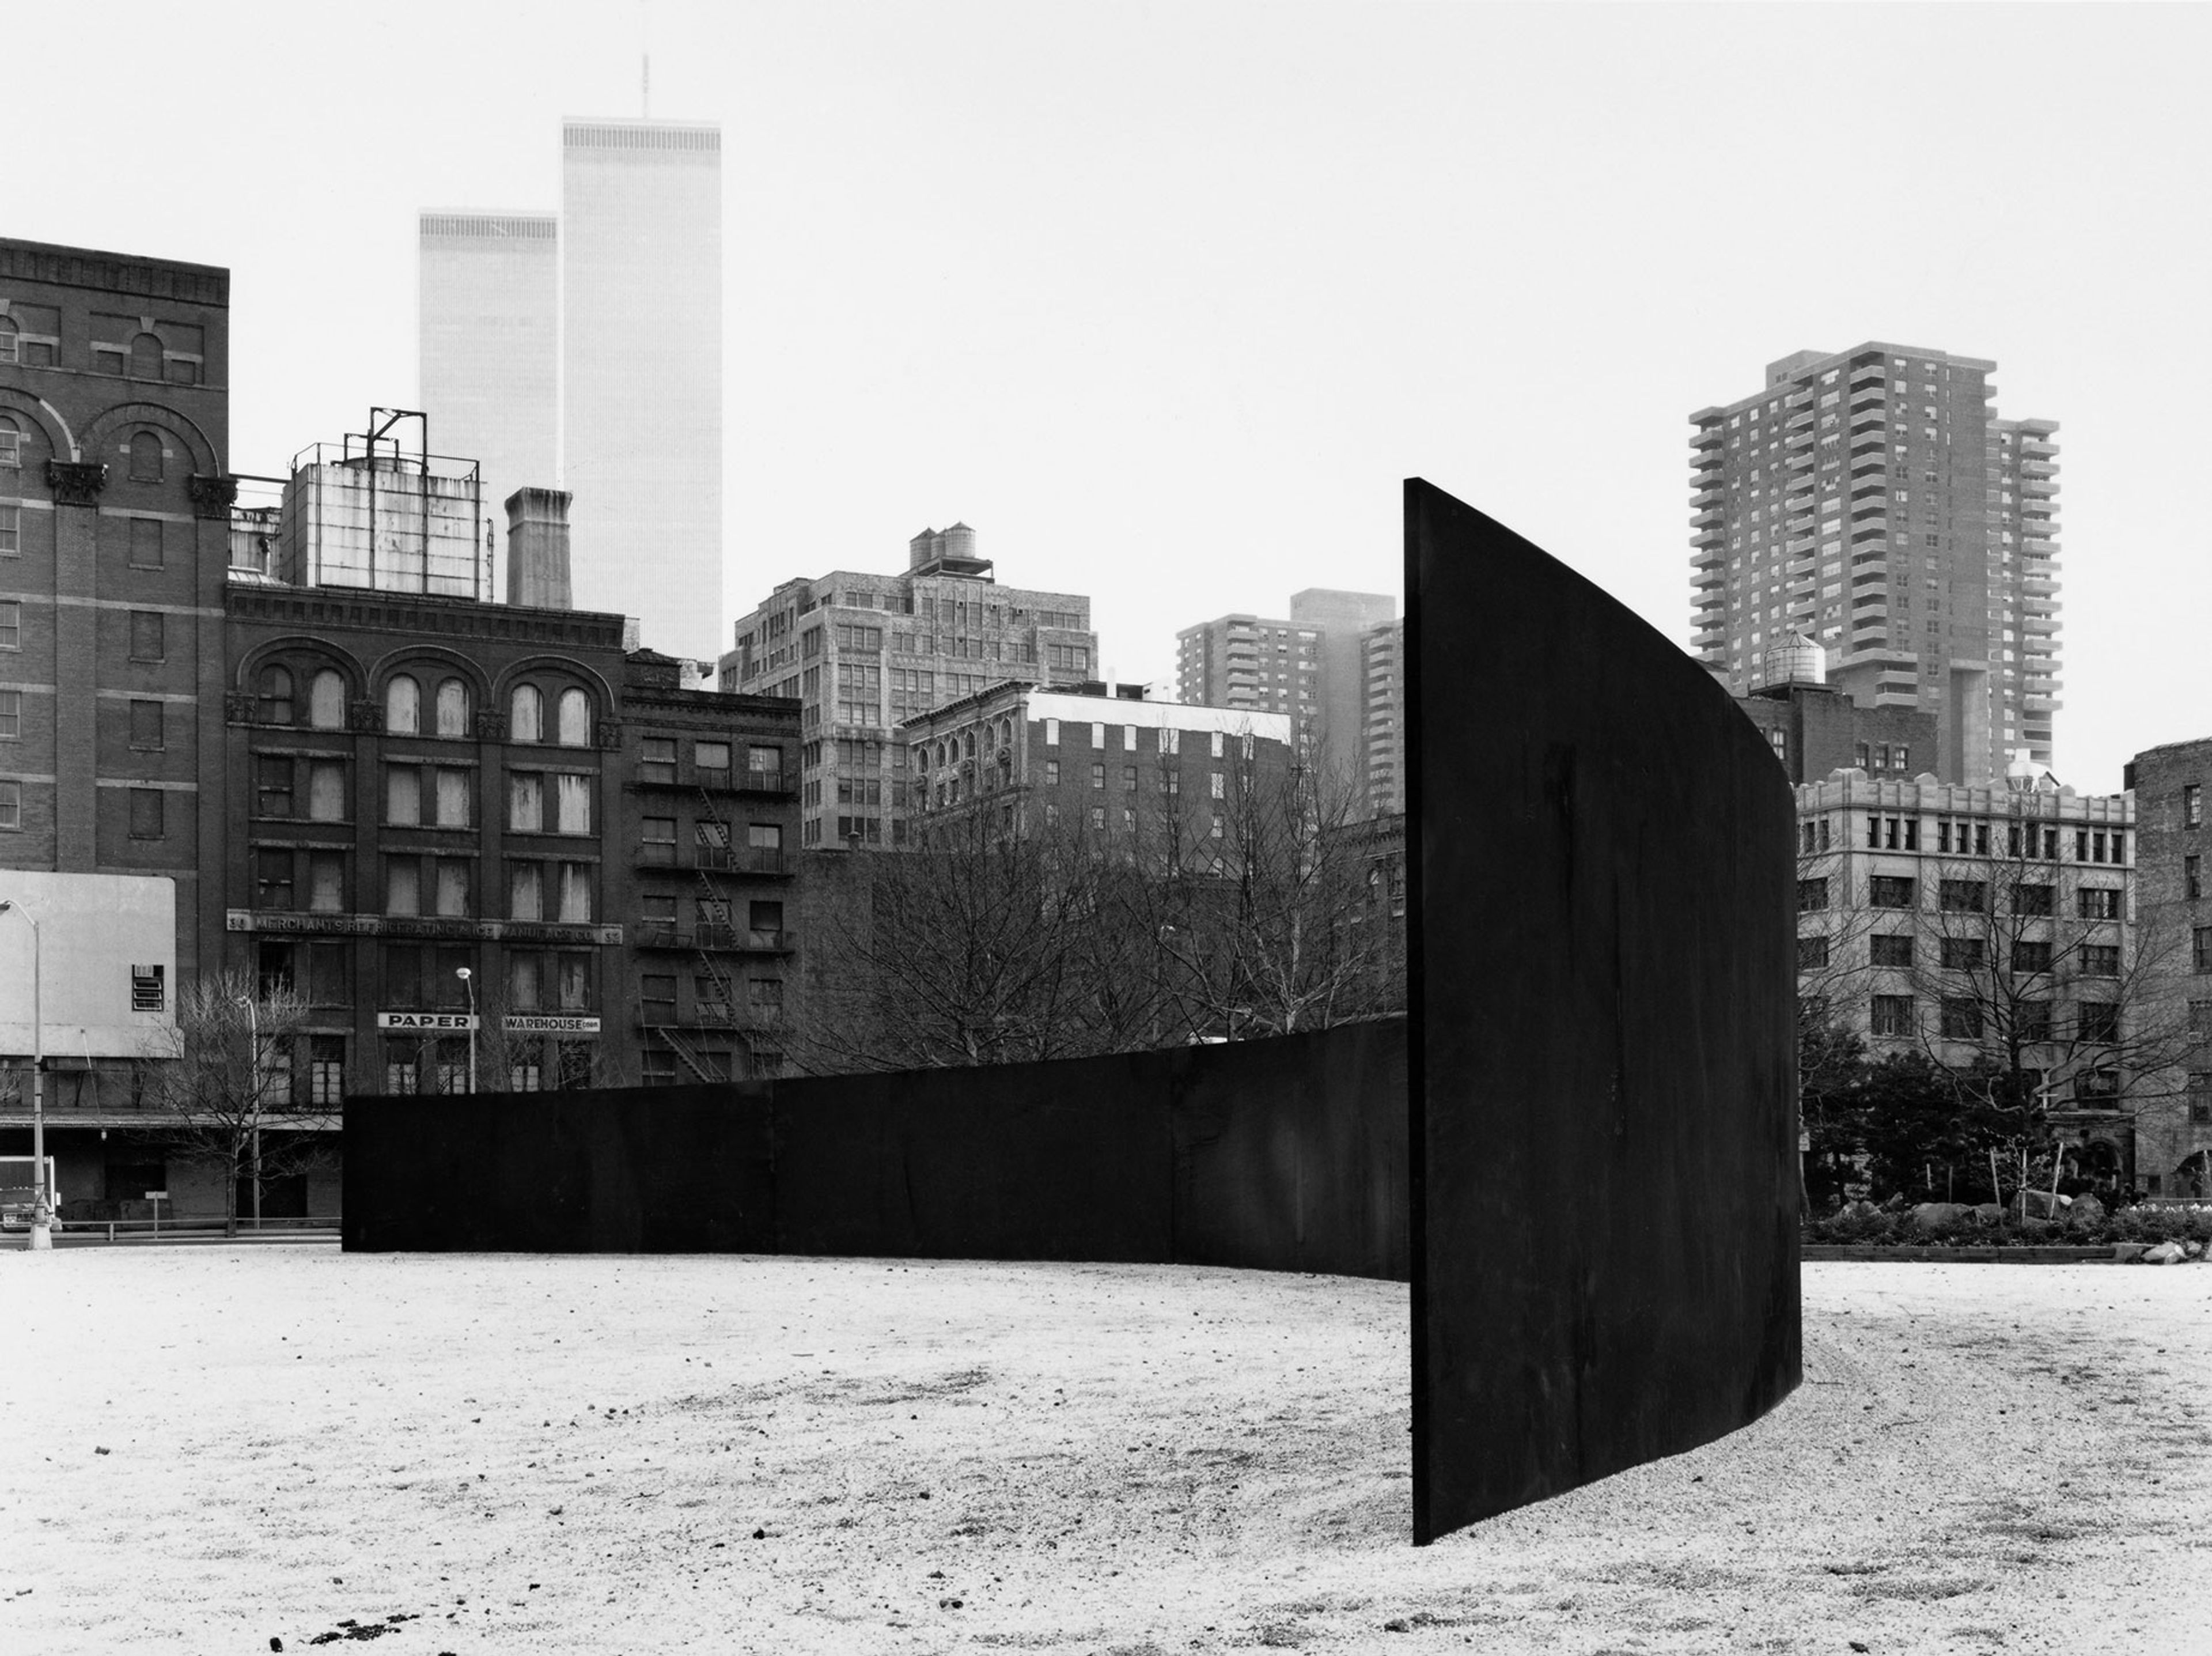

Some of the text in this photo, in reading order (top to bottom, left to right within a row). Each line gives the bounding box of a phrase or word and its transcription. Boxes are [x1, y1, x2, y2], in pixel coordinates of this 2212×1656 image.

[256, 917, 344, 932] MERCHANTS
[472, 925, 494, 936] ICE
[388, 1015, 469, 1027] PAPER
[505, 1018, 582, 1030] WAREHOUSE
